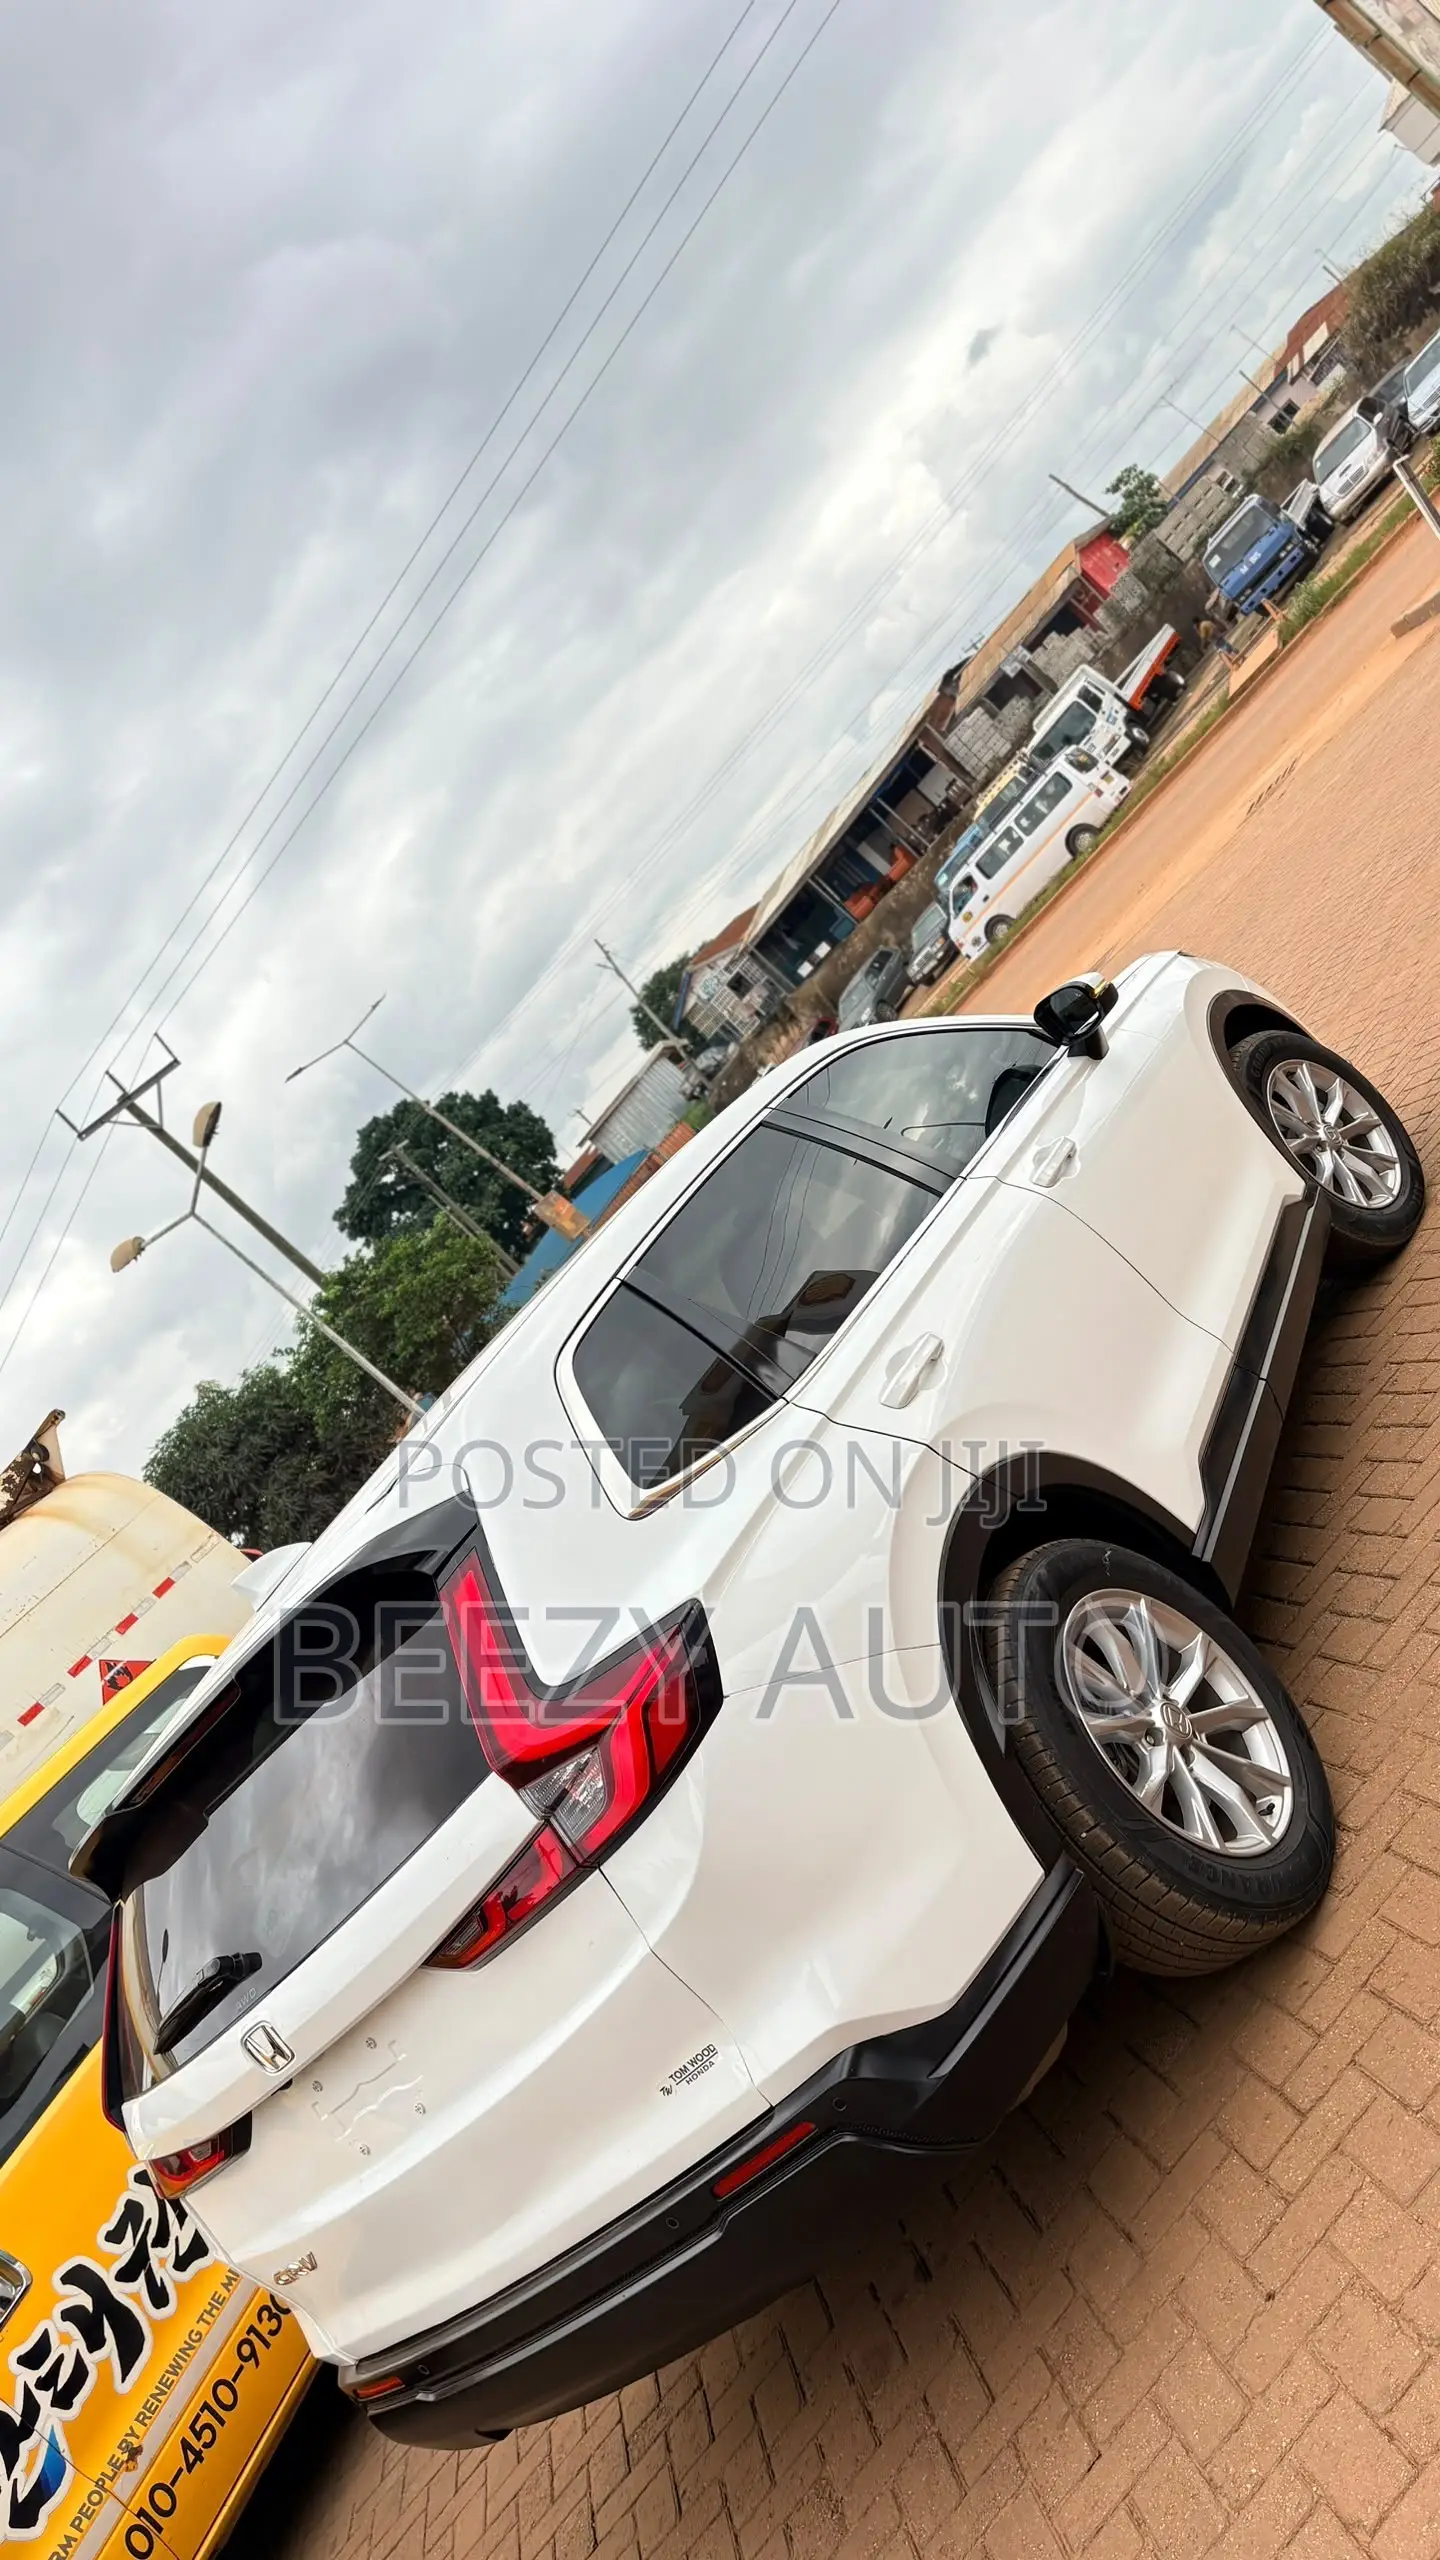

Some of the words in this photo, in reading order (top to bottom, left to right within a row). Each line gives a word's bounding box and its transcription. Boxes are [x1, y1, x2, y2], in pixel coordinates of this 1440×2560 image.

[668, 2064, 690, 2083] TOM
[686, 2043, 717, 2069] WOOD
[685, 2060, 715, 2085] HONDA
[47, 2534, 78, 2560] RM
[70, 2454, 125, 2533] PEOPLE
[116, 2425, 140, 2455] BY
[134, 2328, 201, 2427] RENEWING
[196, 2291, 226, 2326] THE
[220, 2268, 240, 2293] MI
